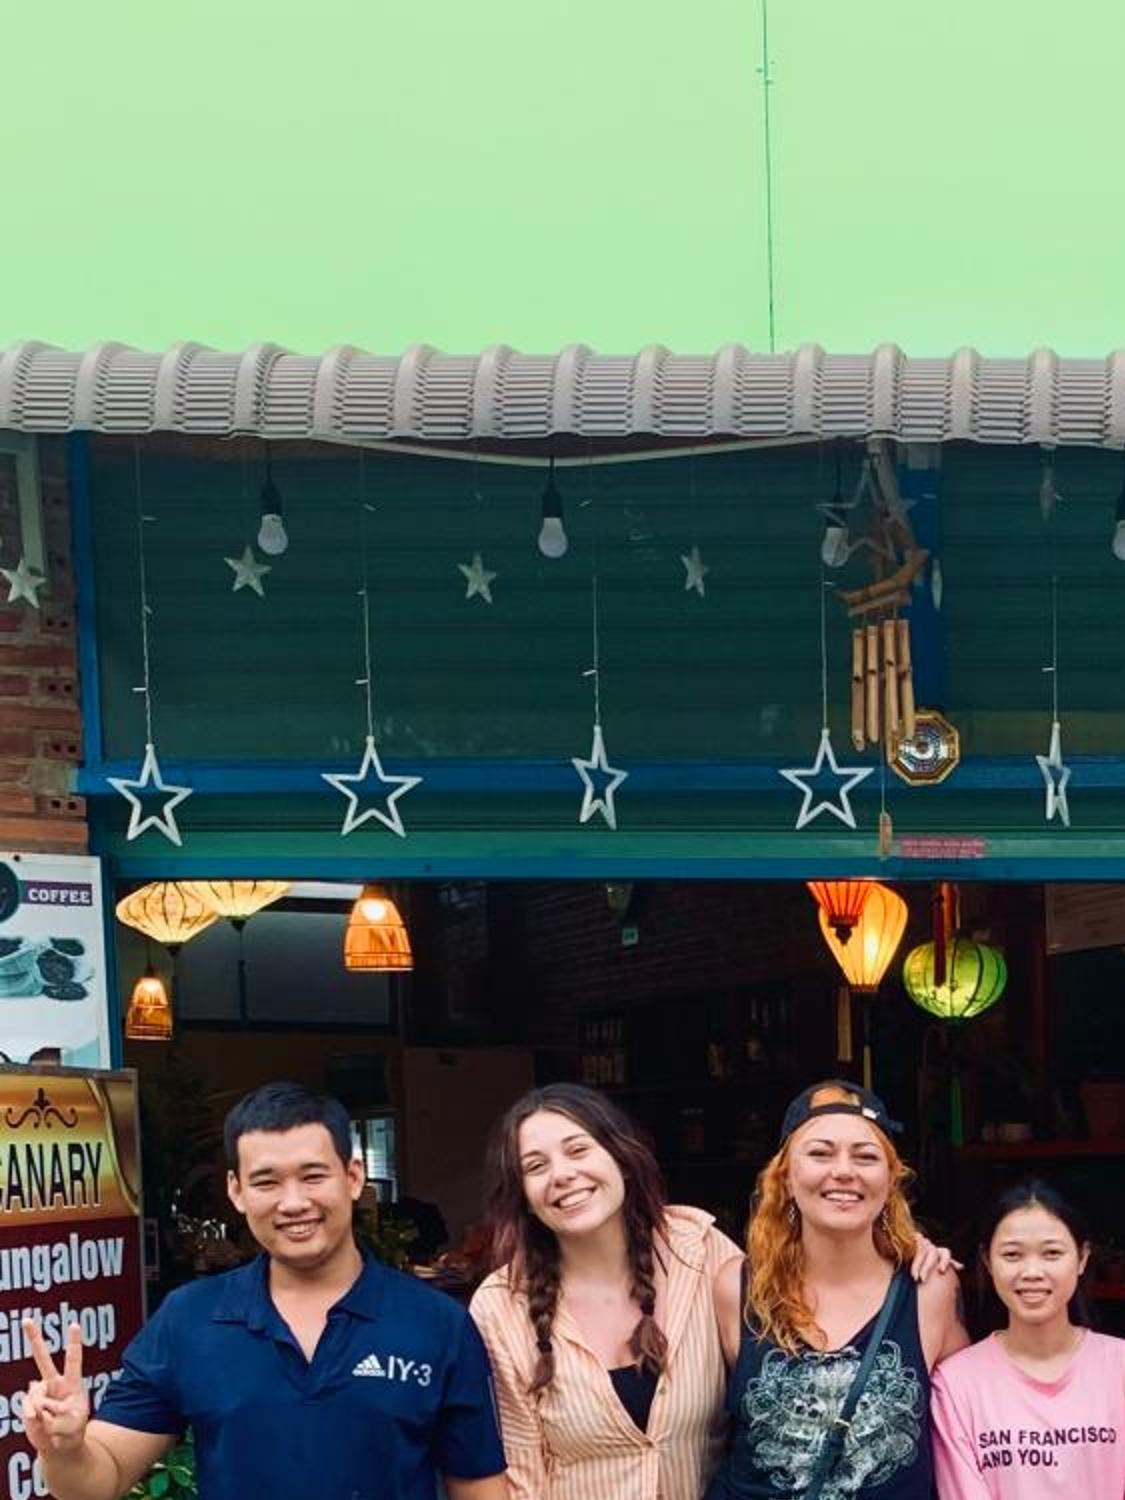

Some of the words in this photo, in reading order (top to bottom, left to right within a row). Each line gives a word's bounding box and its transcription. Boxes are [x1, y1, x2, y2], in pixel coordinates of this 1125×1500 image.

[28, 887, 91, 904] COFFEE
[0, 1143, 102, 1211] ANARY
[979, 1429, 1011, 1448] SAN
[1018, 1426, 1117, 1446] FRANCISCO
[981, 1450, 1013, 1469] AND
[1018, 1449, 1059, 1468] YOU.
